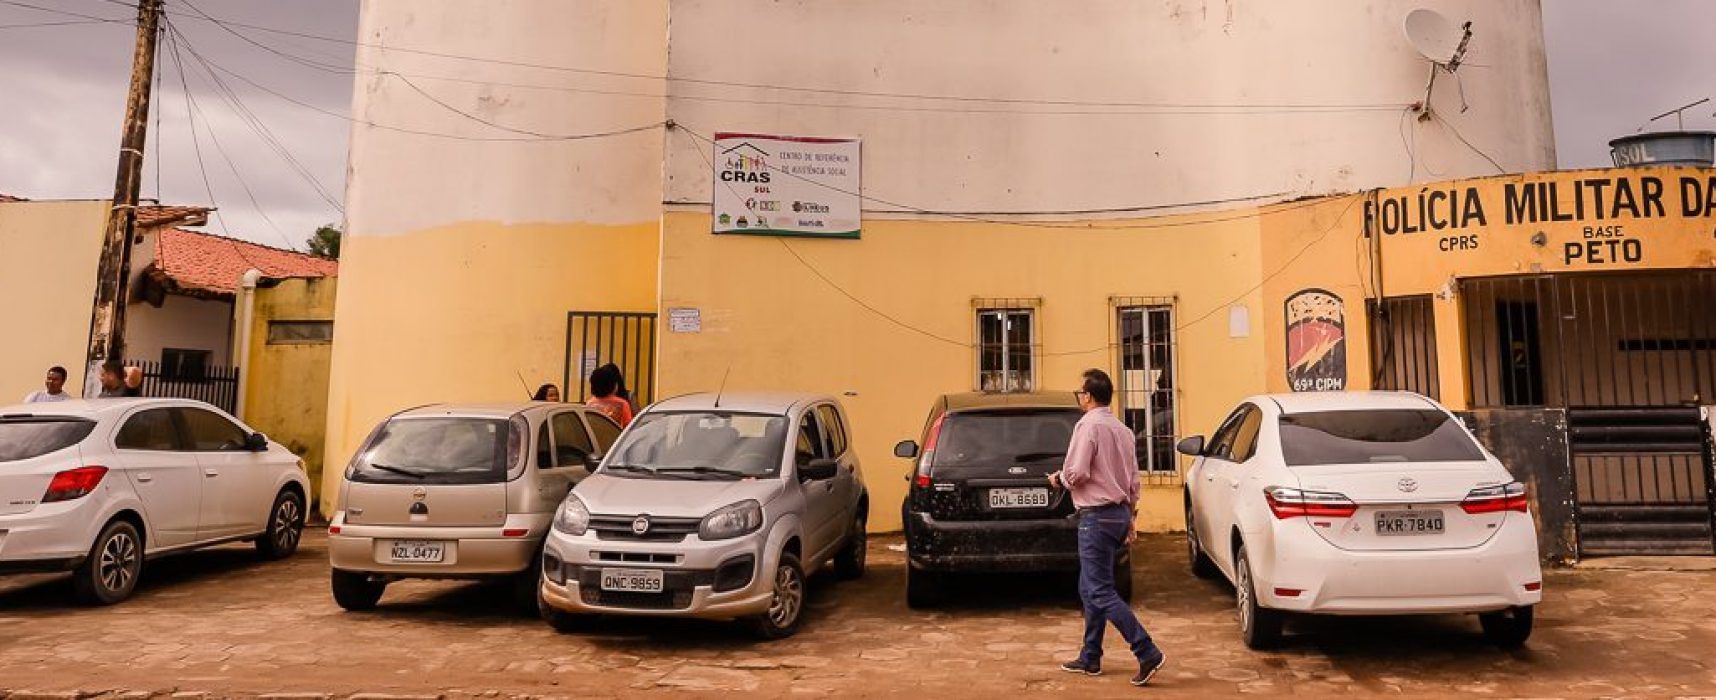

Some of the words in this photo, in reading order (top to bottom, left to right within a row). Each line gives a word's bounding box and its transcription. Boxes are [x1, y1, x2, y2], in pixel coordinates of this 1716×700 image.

[779, 151, 802, 160] CENTRO
[720, 170, 771, 183] CRAS
[1364, 187, 1487, 239] POLÍCIA
[1504, 177, 1667, 225] MILITAR
[1583, 226, 1625, 239] BASE
[1439, 234, 1479, 252] CPRS
[1564, 239, 1643, 265] PETO
